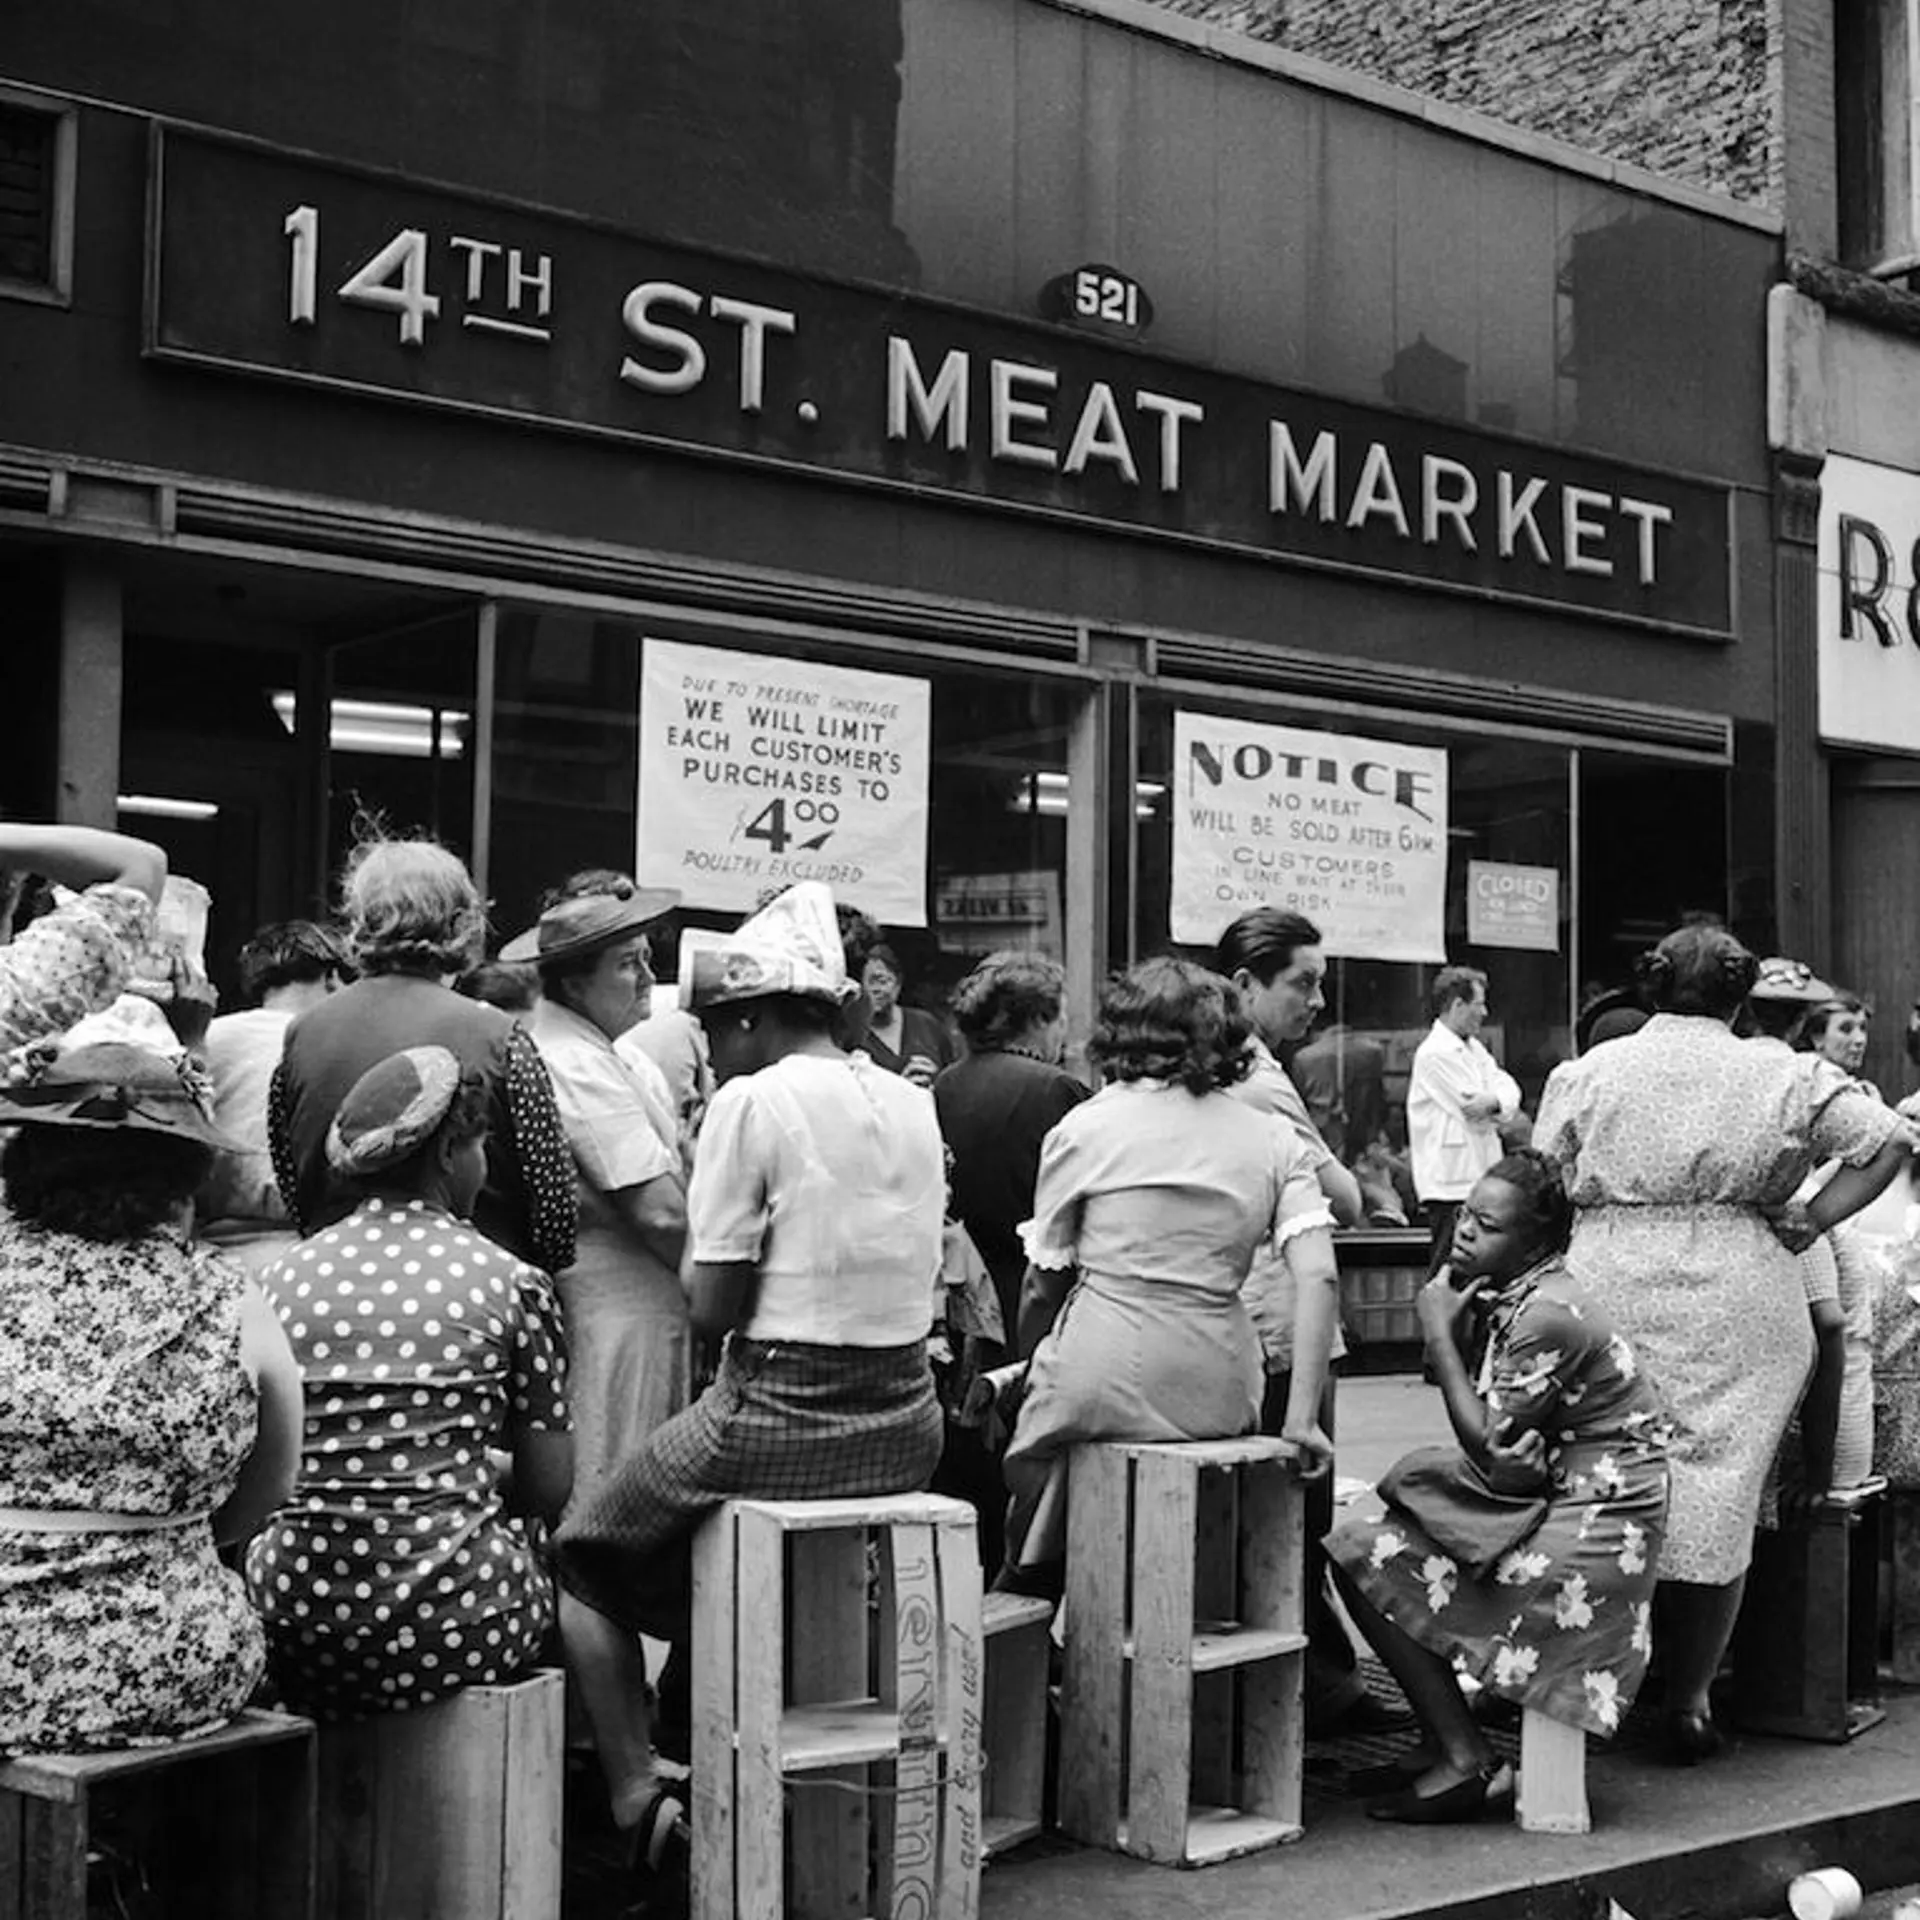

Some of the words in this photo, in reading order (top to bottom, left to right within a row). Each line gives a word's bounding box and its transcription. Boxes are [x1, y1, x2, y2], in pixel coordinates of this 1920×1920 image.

[1075, 271, 1138, 326] 521
[284, 205, 551, 346] 14TH
[620, 281, 819, 421] ST.
[886, 335, 1203, 493] MEAT
[1268, 418, 1674, 585] MARKET
[727, 681, 748, 698] TO
[754, 685, 820, 707] PRESENT
[684, 698, 723, 723] WE
[747, 705, 805, 735] WILL
[817, 715, 886, 743] LIMIT
[667, 726, 731, 752] EACH
[750, 736, 902, 775] CUSTOMER'S
[683, 757, 843, 796] PURCHASES
[858, 778, 890, 802] TO
[1189, 740, 1435, 824] NOTICE
[1268, 792, 1302, 811] NO
[1311, 797, 1362, 817] MEAT
[1189, 809, 1237, 833] WILL
[1250, 814, 1274, 837] BE
[1289, 819, 1340, 844] SOLD
[1349, 825, 1392, 849] AFTER
[681, 849, 762, 875] POULTRY
[768, 858, 864, 885] EXCLUDED
[1232, 845, 1396, 879] CUSTOMERS
[1243, 869, 1284, 886] LINE
[1296, 874, 1333, 888] WAIT
[1340, 878, 1357, 892] AT
[1216, 884, 1266, 902] OWN
[1286, 892, 1331, 910] RISK
